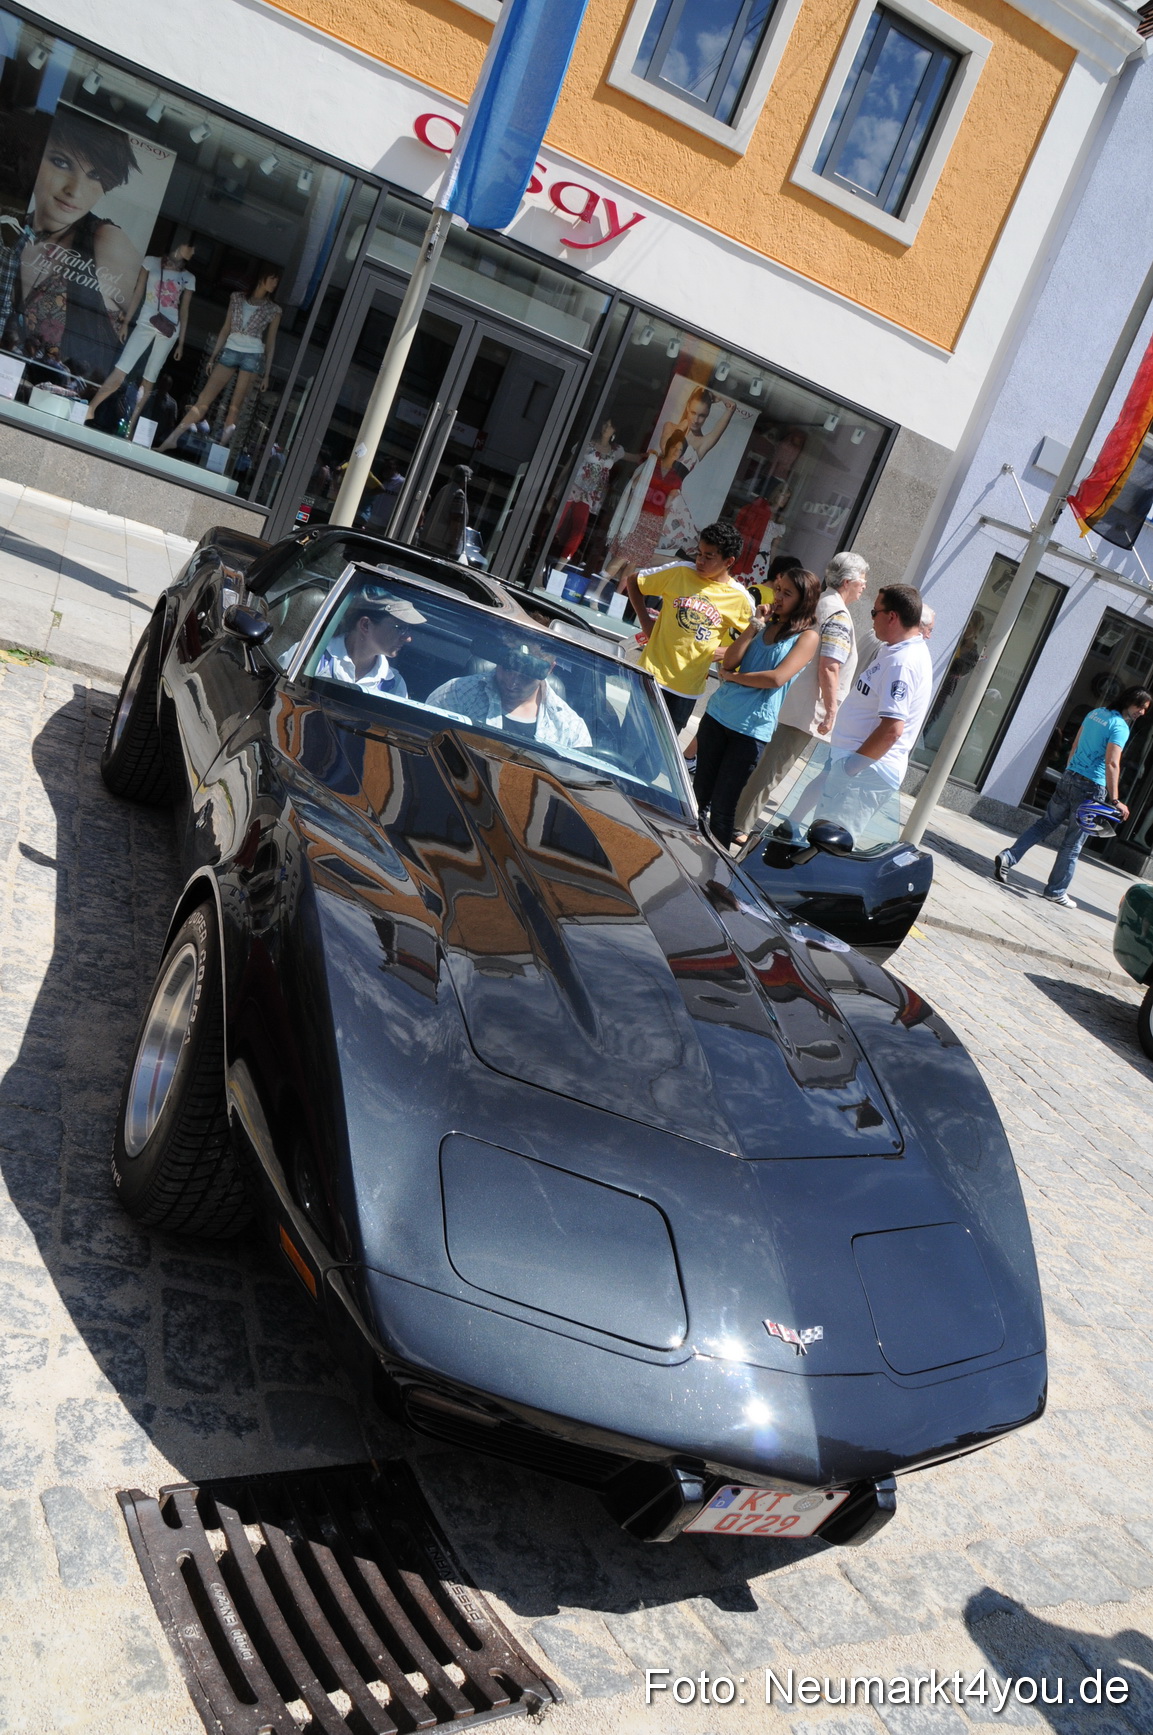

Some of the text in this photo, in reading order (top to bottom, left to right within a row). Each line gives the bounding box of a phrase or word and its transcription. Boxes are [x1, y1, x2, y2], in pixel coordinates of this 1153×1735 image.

[130, 138, 170, 160] orsay
[413, 113, 647, 250] osay
[22, 253, 125, 304] I'm a woman
[43, 243, 123, 284] Thank God
[673, 597, 723, 628] STANFORD
[694, 625, 712, 642] 52
[184, 949, 207, 1045] COBRA
[715, 1500, 726, 1508] D
[738, 1491, 792, 1513] KT
[713, 1514, 801, 1534] 0729
[427, 1545, 480, 1621] PASSAVANT
